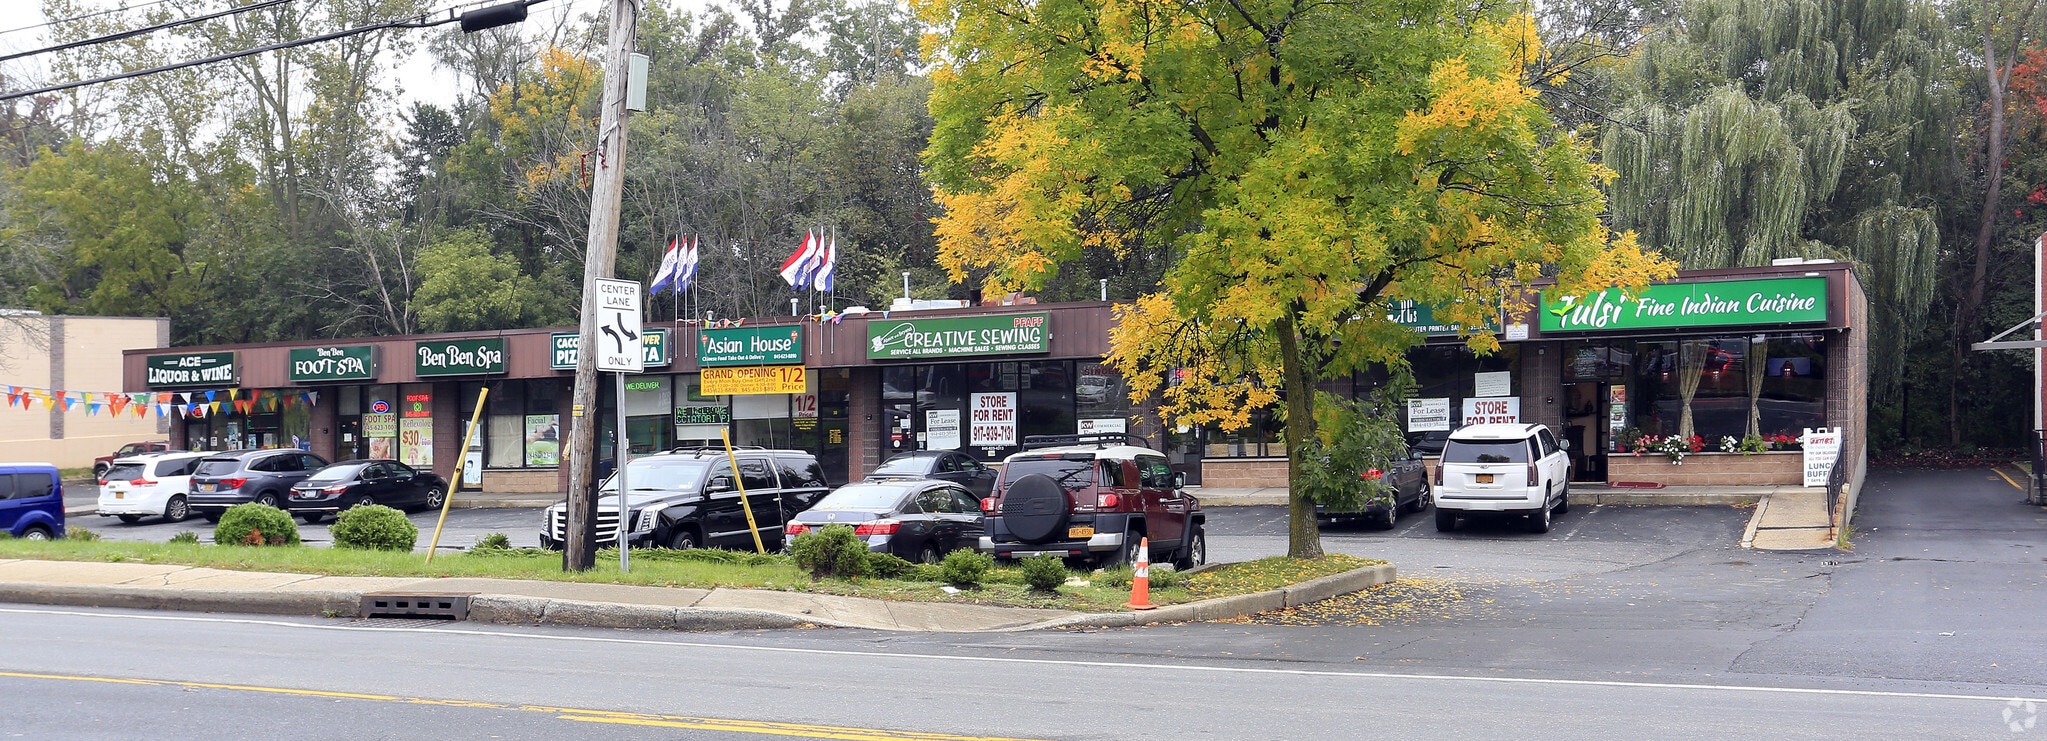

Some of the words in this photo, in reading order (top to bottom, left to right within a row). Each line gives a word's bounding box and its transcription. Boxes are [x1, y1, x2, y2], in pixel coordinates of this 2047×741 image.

[601, 284, 635, 295] CENTER
[606, 296, 631, 306] LANE
[1559, 291, 1627, 329] Tulsi
[1635, 297, 1675, 317] Fine
[1681, 293, 1740, 316] Indian
[1746, 292, 1816, 314] Cuisine
[1013, 317, 1043, 328] PFAFF
[904, 330, 977, 348] CREATIVE
[981, 327, 1041, 345] SEWING
[707, 337, 743, 353] Asian
[750, 335, 792, 352] House
[922, 347, 943, 355] BRANDS
[948, 346, 973, 354] MACHINE
[1017, 343, 1040, 351] CLASSES
[317, 347, 331, 357] Ben
[330, 347, 344, 356] Ben
[418, 346, 447, 369] Ben
[446, 345, 475, 367] Ben
[476, 345, 502, 369] Spa
[179, 356, 201, 367] ACE
[295, 358, 336, 374] FOOT
[336, 357, 366, 375] SPA
[608, 356, 632, 365] ONLY
[148, 367, 190, 383] LIQUOR
[191, 370, 200, 382] &
[200, 363, 232, 381] WINE
[703, 369, 733, 379] GRAND
[737, 367, 777, 378] OPENING
[780, 367, 804, 382] 1/2
[795, 395, 816, 411] 1/2
[981, 396, 1007, 408] STORE
[1475, 401, 1508, 414] STORE
[364, 415, 382, 423] FOOT
[974, 410, 990, 421] FOR
[992, 409, 1014, 421] RENT
[1490, 416, 1516, 424] RENT
[1082, 421, 1093, 429] KW
[402, 430, 419, 446] $30
[973, 426, 1014, 441] 917-939-7131
